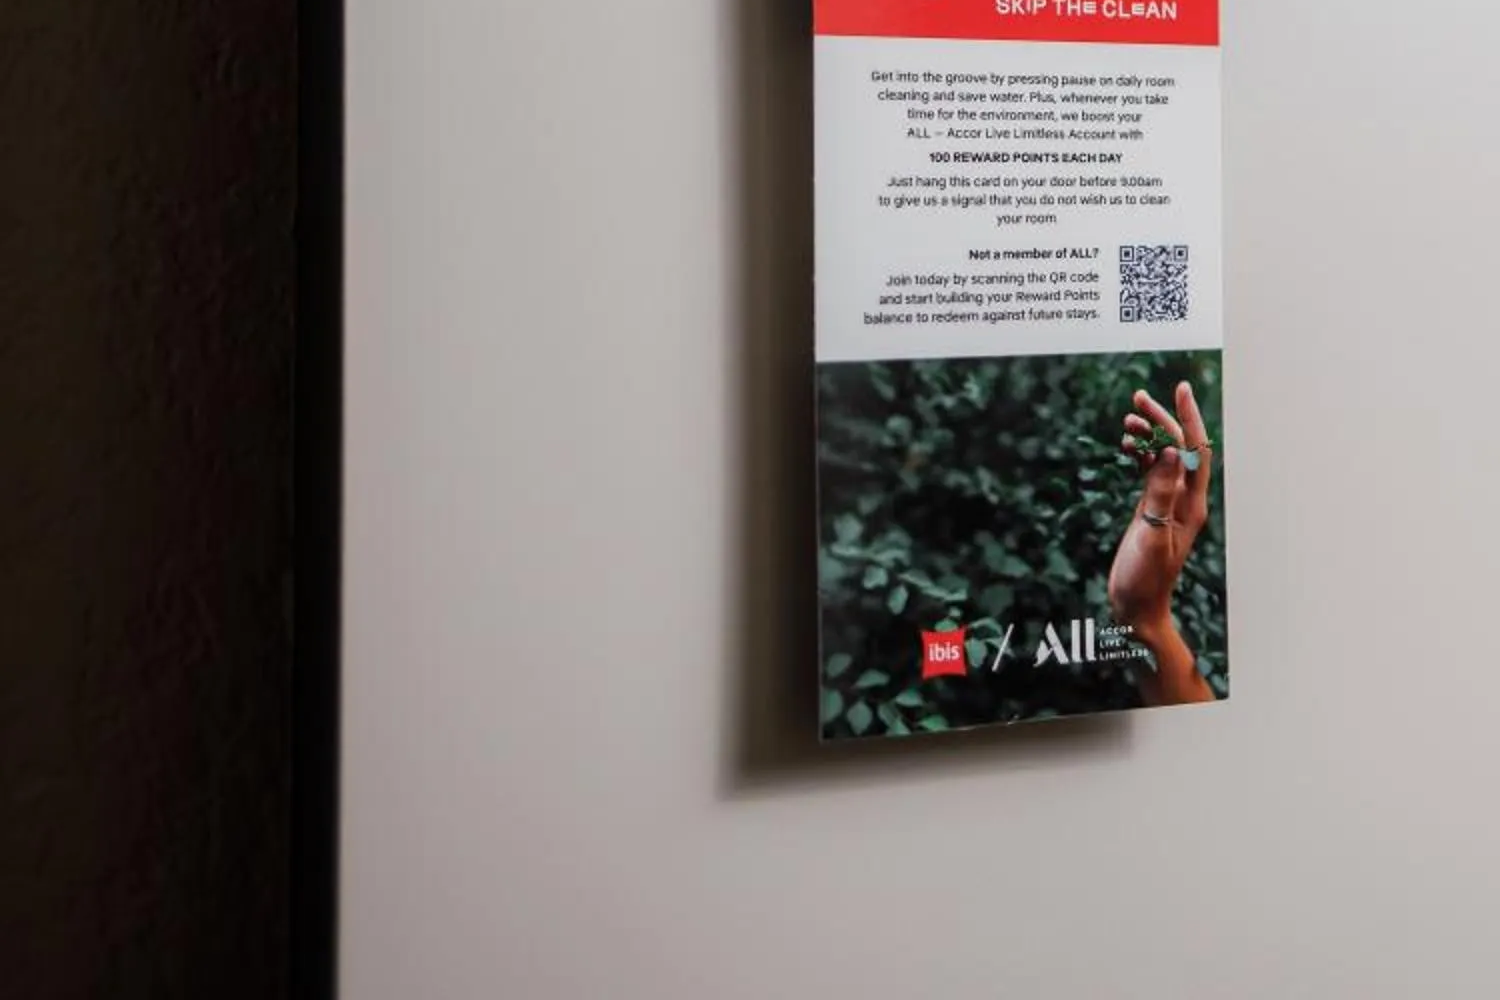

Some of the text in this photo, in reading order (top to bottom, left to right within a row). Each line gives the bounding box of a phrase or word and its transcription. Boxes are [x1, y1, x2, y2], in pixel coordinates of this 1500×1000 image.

[871, 70, 1176, 88] Get into the groove by pressing pause on daily room
[877, 88, 930, 105] cleaning
[932, 90, 955, 102] and
[958, 92, 987, 102] save
[1059, 92, 1118, 104] whenever
[1120, 95, 1143, 107] you
[1144, 93, 1169, 105] take
[907, 108, 935, 120] time
[937, 108, 954, 120] for
[957, 108, 978, 121] the
[1060, 112, 1079, 122] we
[1081, 110, 1114, 122] boost
[1116, 113, 1143, 124] your
[906, 127, 931, 139] ALL
[947, 127, 983, 139] Accor
[985, 126, 1011, 140] Live
[1013, 128, 1065, 140] Limitless
[1068, 128, 1116, 140] Account
[1118, 129, 1144, 140] with
[929, 151, 1123, 164] 100 REWARD POINTS EACH DAY
[887, 176, 913, 188] Just
[915, 176, 947, 191] hang
[948, 176, 971, 188] this
[973, 176, 1001, 187] card
[1003, 178, 1018, 188] on
[1020, 177, 1047, 190] your
[1049, 176, 1077, 188] door
[1078, 175, 1117, 187] before
[878, 193, 1171, 208] to give us a signal that you do not wish us to clean
[996, 214, 1057, 227] your room
[968, 247, 1100, 262] Not a member of ALL?
[885, 270, 1100, 289] Join today by scanning the QR code
[879, 289, 1101, 307] and start building your Reward Points
[863, 312, 914, 325] balance
[916, 312, 929, 323] to
[931, 310, 980, 323] redeem
[982, 308, 1026, 325] against
[1027, 308, 1061, 321] future
[928, 642, 961, 663] ibis
